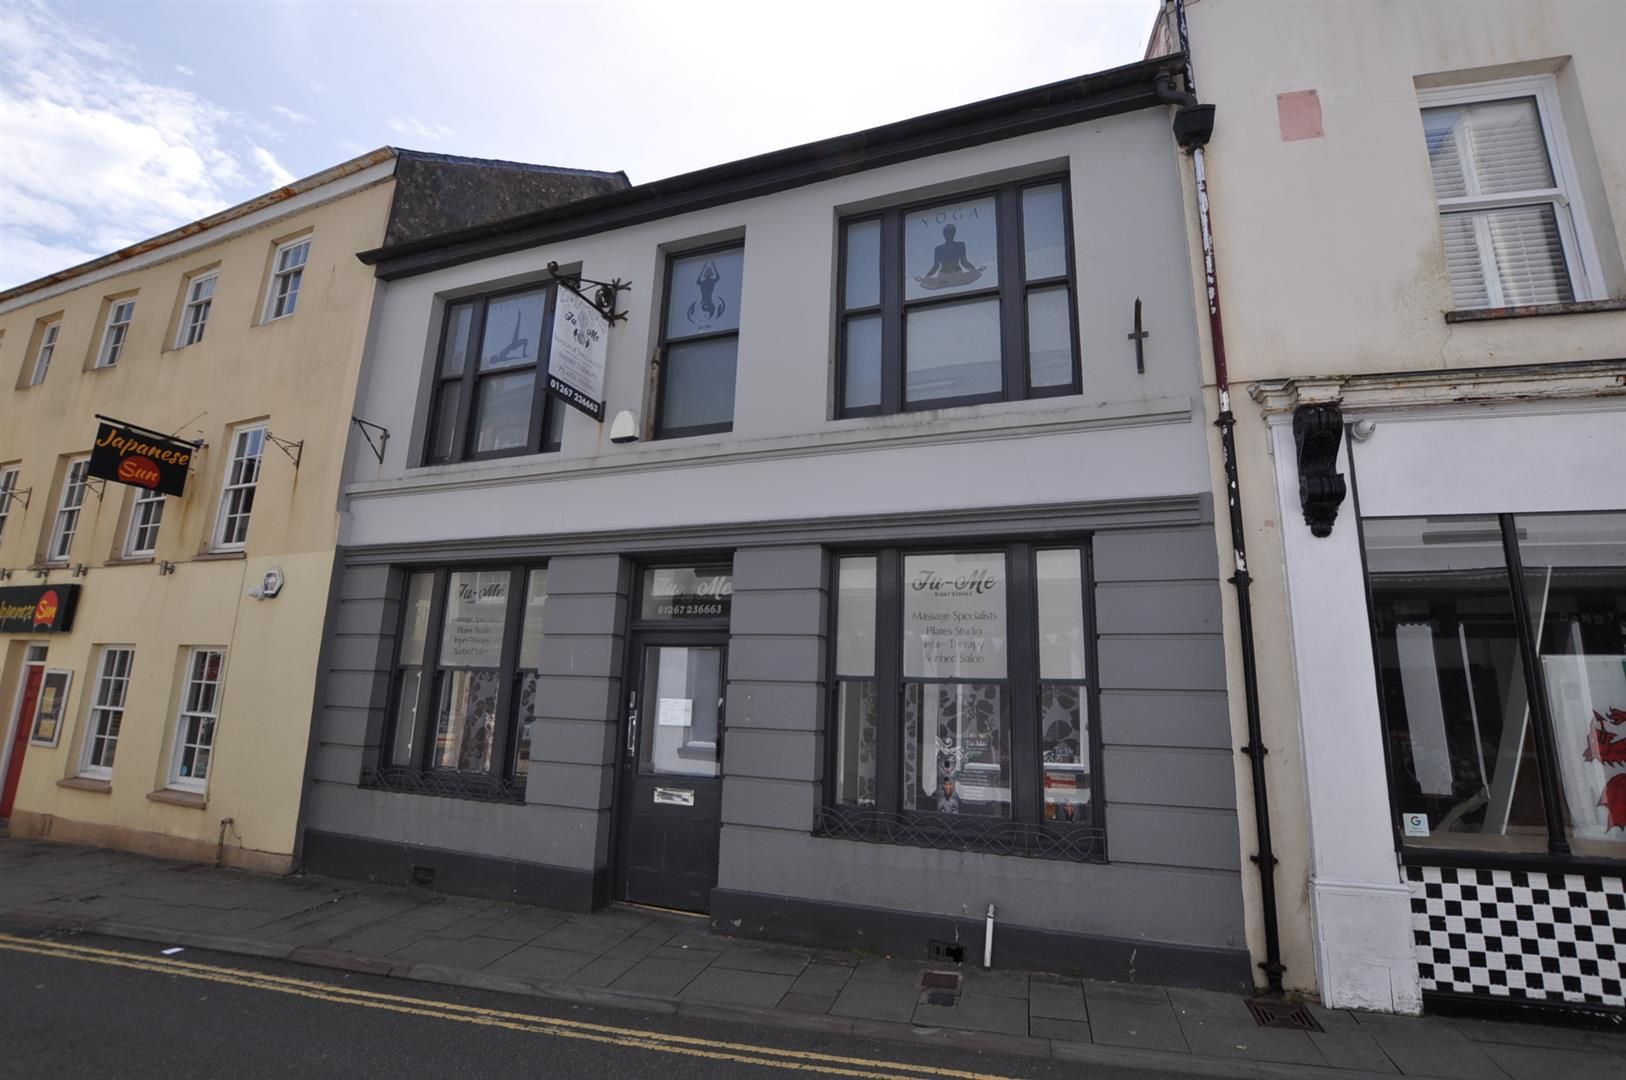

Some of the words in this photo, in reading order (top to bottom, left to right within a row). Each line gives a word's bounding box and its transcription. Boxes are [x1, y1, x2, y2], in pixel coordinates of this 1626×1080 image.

[921, 208, 978, 228] YOGA
[550, 379, 573, 397] 01267
[96, 428, 190, 465] Japanese
[119, 460, 160, 482] Sun
[36, 600, 57, 619] Sun
[657, 605, 686, 615] 01267
[686, 604, 722, 615] 236663
[911, 611, 951, 624] Massage
[952, 609, 998, 623] Specialists
[926, 626, 953, 636] Pilates
[954, 625, 983, 636] Studio
[960, 653, 985, 663] Salon
